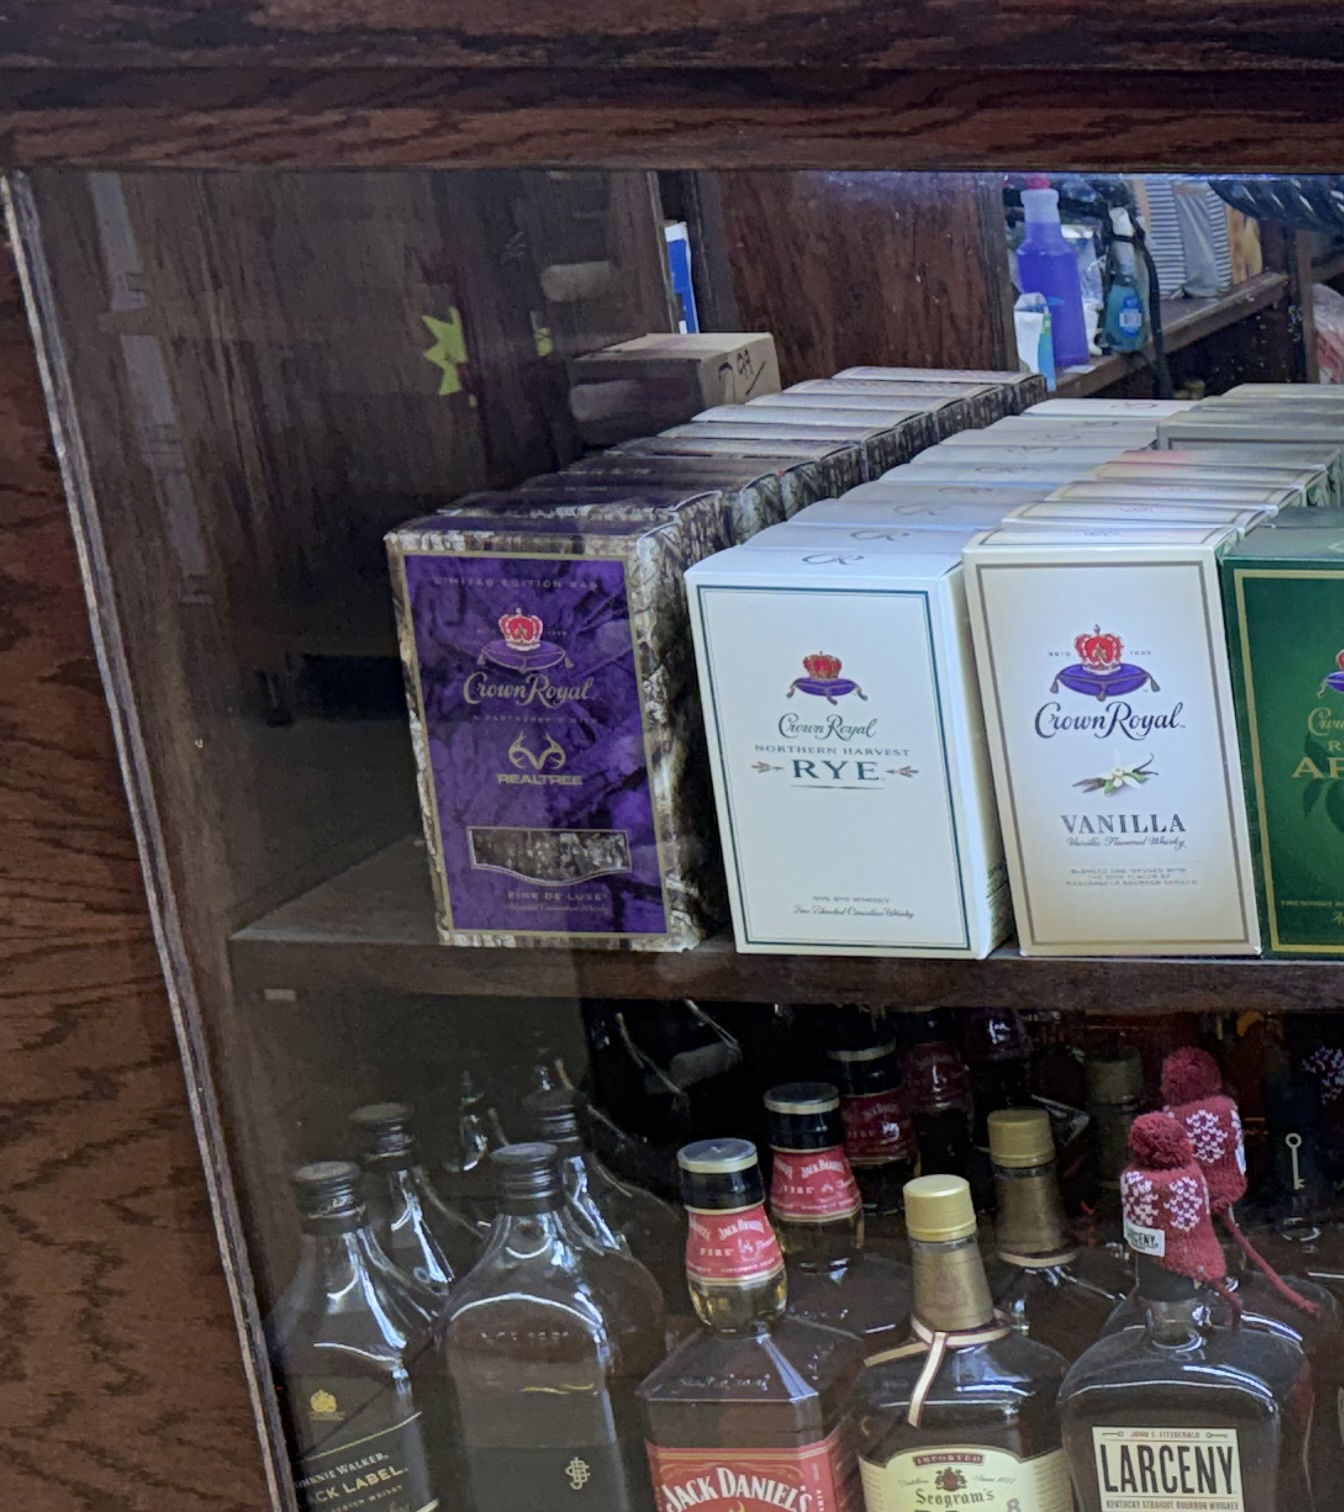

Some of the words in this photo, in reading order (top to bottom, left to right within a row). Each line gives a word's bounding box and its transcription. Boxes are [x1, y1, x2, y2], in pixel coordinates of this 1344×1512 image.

[463, 671, 527, 705] Crown
[515, 673, 595, 709] Royal
[777, 712, 826, 739] Crown
[813, 713, 879, 742] Royal
[1034, 701, 1108, 739] Crown
[1093, 700, 1184, 742] Royal
[753, 743, 838, 756] NORTHERN
[842, 747, 912, 757] HARVEST
[496, 773, 584, 786] REALTREE
[791, 758, 881, 781] RYE
[1059, 813, 1187, 835] VANILLA
[335, 1452, 385, 1476] WALKER
[1100, 1443, 1234, 1495] LARCENY
[342, 1465, 405, 1494] LABEL
[914, 1487, 996, 1508] Seagram's
[1106, 1500, 1141, 1510] KENTUCKY
